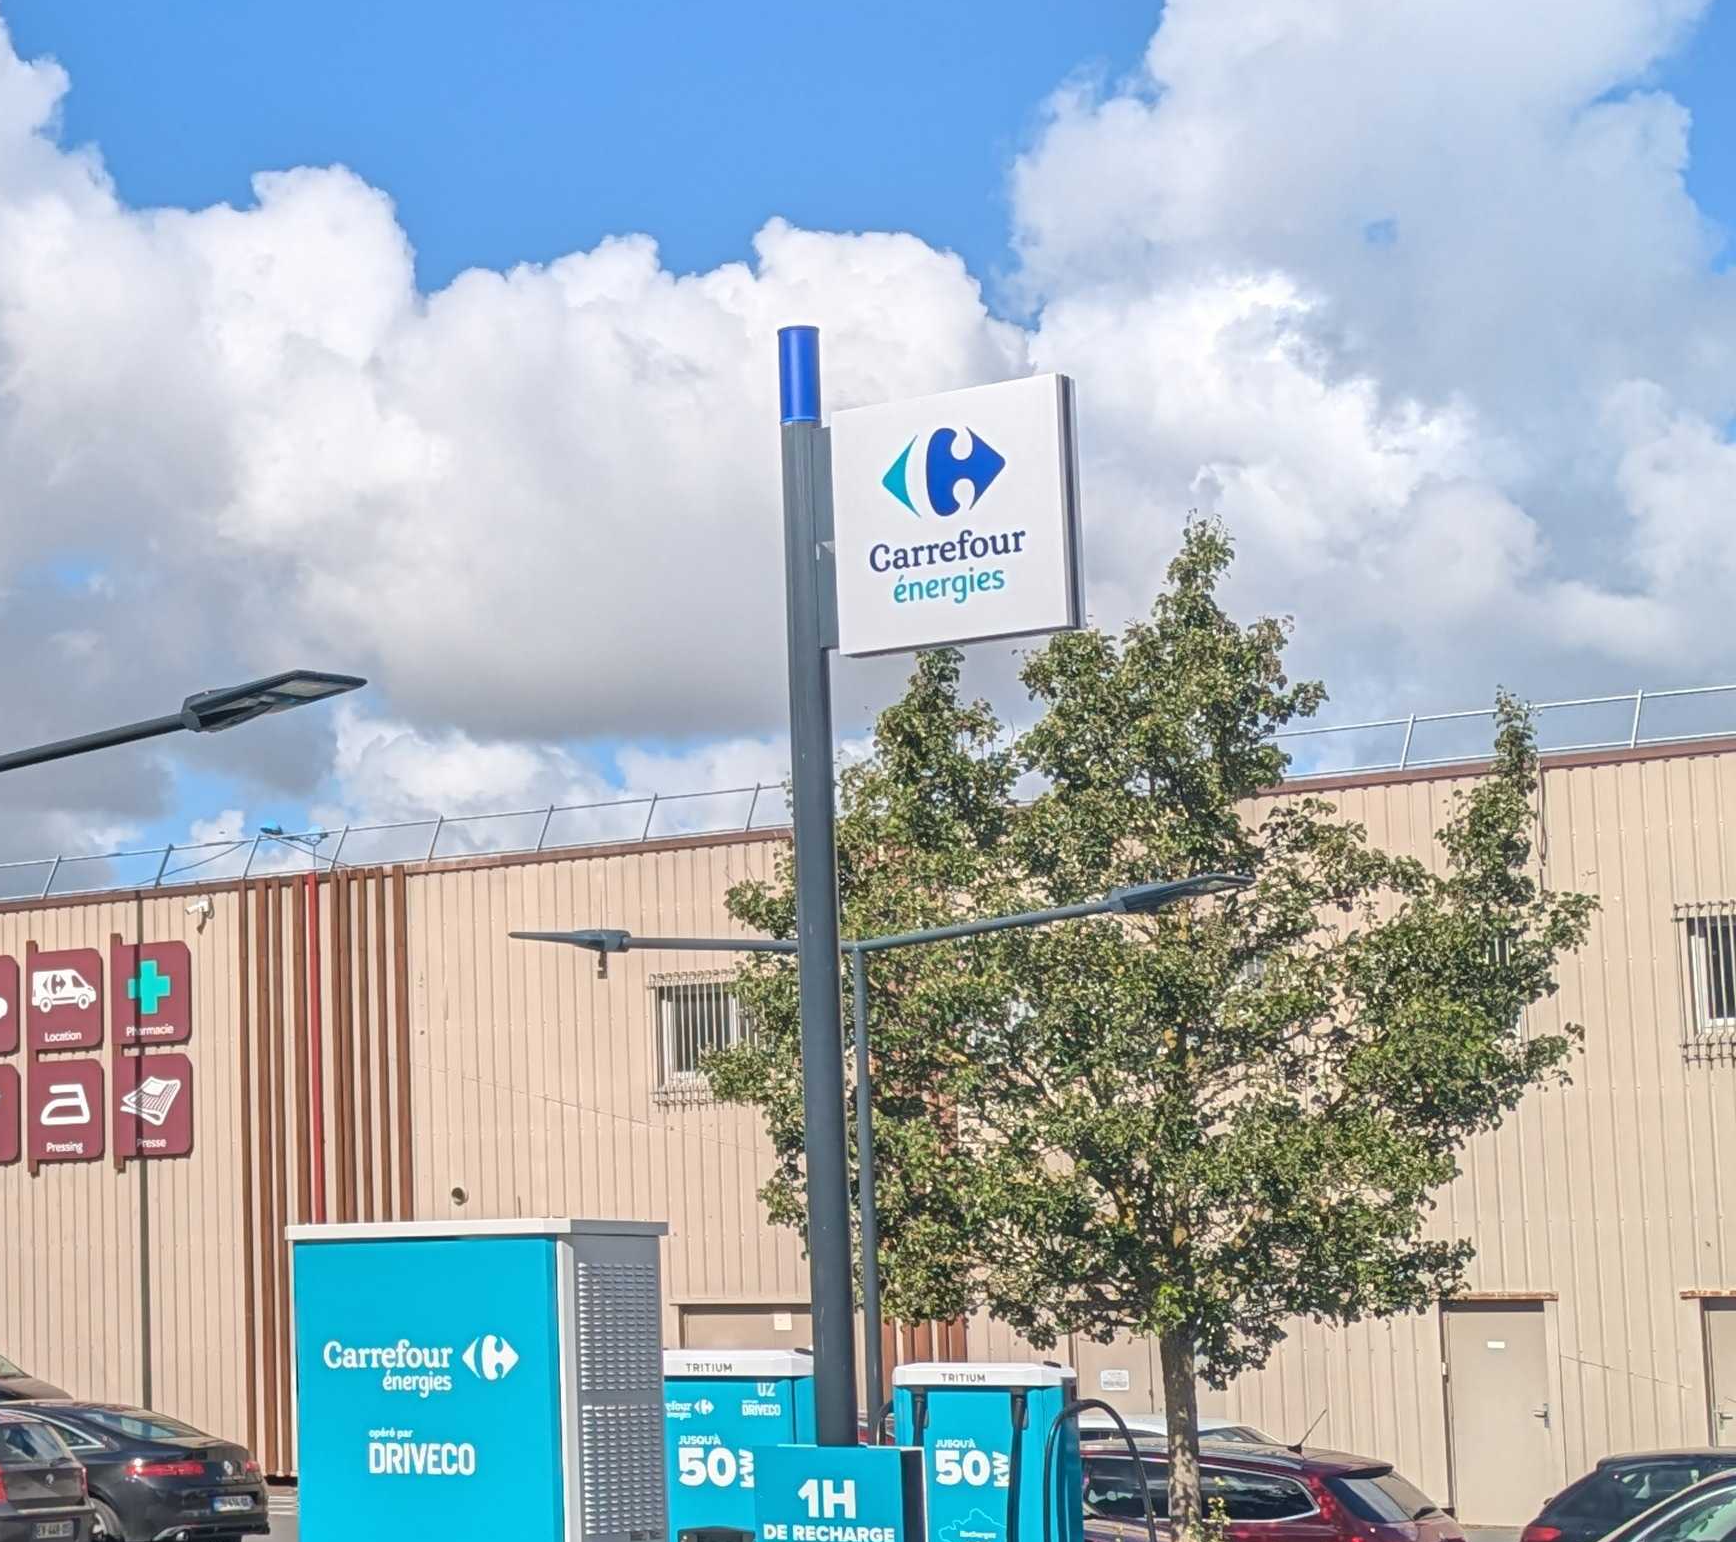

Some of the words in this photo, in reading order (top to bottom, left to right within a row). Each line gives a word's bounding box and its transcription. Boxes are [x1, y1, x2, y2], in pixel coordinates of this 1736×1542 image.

[869, 529, 1026, 572] Carrefour
[893, 567, 1005, 603] énergies
[45, 1031, 82, 1042] Location
[126, 1024, 174, 1037] Pharmacie
[46, 1141, 83, 1154] Pressing
[137, 1138, 167, 1149] Presse
[323, 1339, 453, 1369] Carrefour
[686, 1363, 733, 1372] TRITIUM
[382, 1369, 452, 1398] énergies
[941, 1373, 986, 1382] TRITIUM
[742, 1403, 781, 1416] DRIVECO
[368, 1427, 395, 1439] opéré
[397, 1429, 413, 1439] par
[678, 1433, 722, 1445] JUSQU'À
[368, 1442, 476, 1476] DRIVECO
[678, 1447, 736, 1487] 50
[936, 1450, 991, 1487] 50
[798, 1479, 857, 1519] 1H
[764, 1524, 788, 1540] DE
